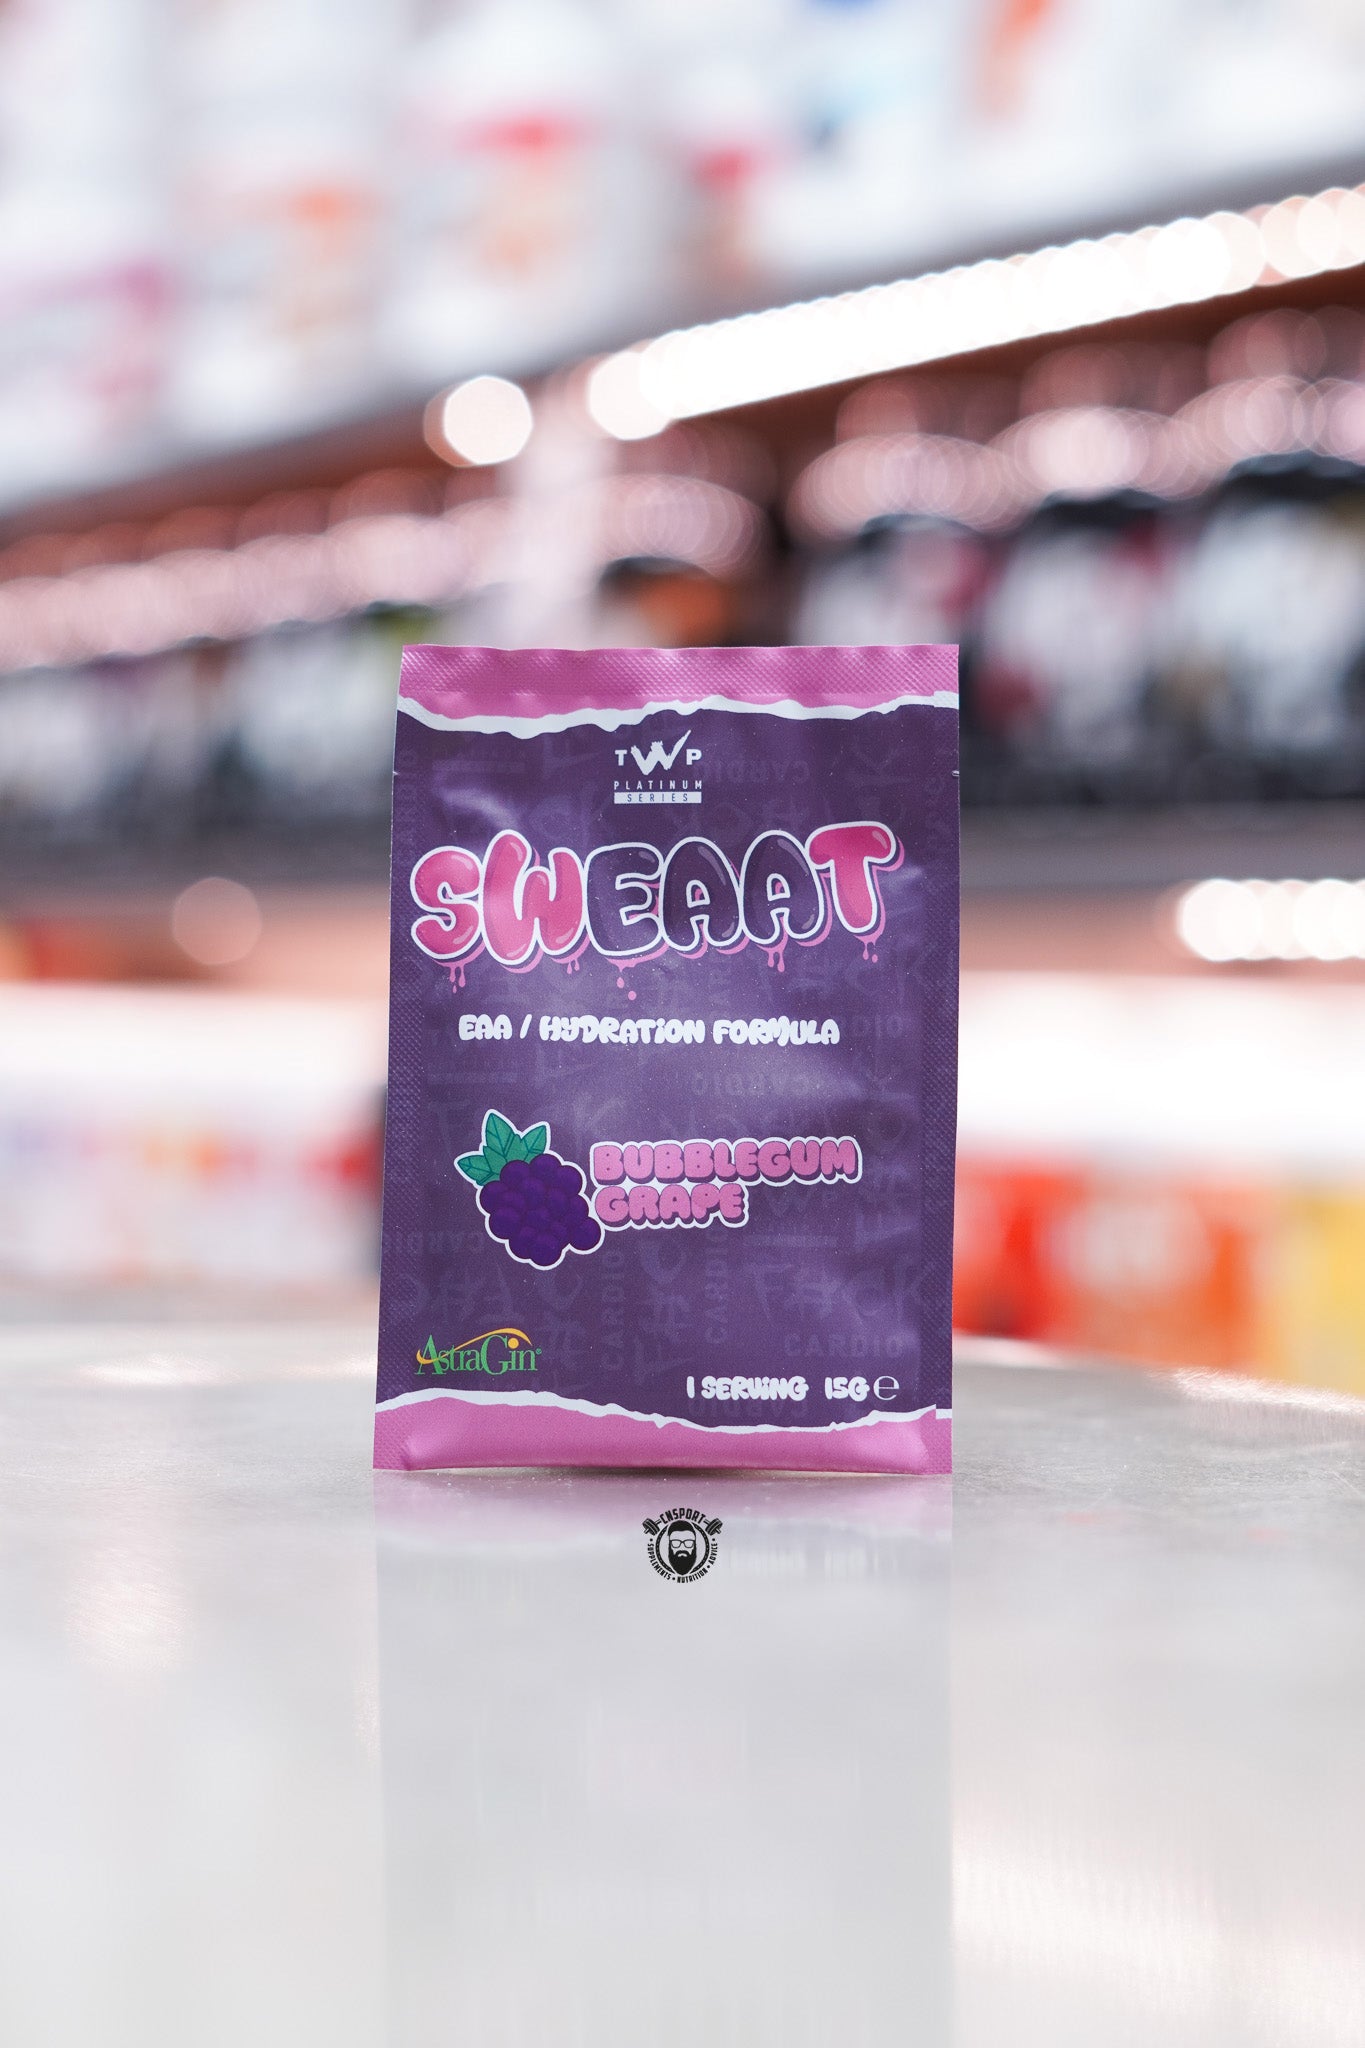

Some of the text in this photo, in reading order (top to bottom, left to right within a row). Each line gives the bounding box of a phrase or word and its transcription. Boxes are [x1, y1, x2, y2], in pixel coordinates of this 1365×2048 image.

[614, 729, 702, 776] TWP
[613, 780, 702, 790] PLATINUM
[627, 793, 688, 802] SERIES
[410, 821, 903, 972] SWEAAT
[458, 1014, 512, 1040] EAA
[519, 1014, 532, 1039] /
[712, 1016, 840, 1047] FORMULA
[591, 1138, 861, 1185] BUBBLEGUM
[594, 1183, 747, 1228] GRAPE
